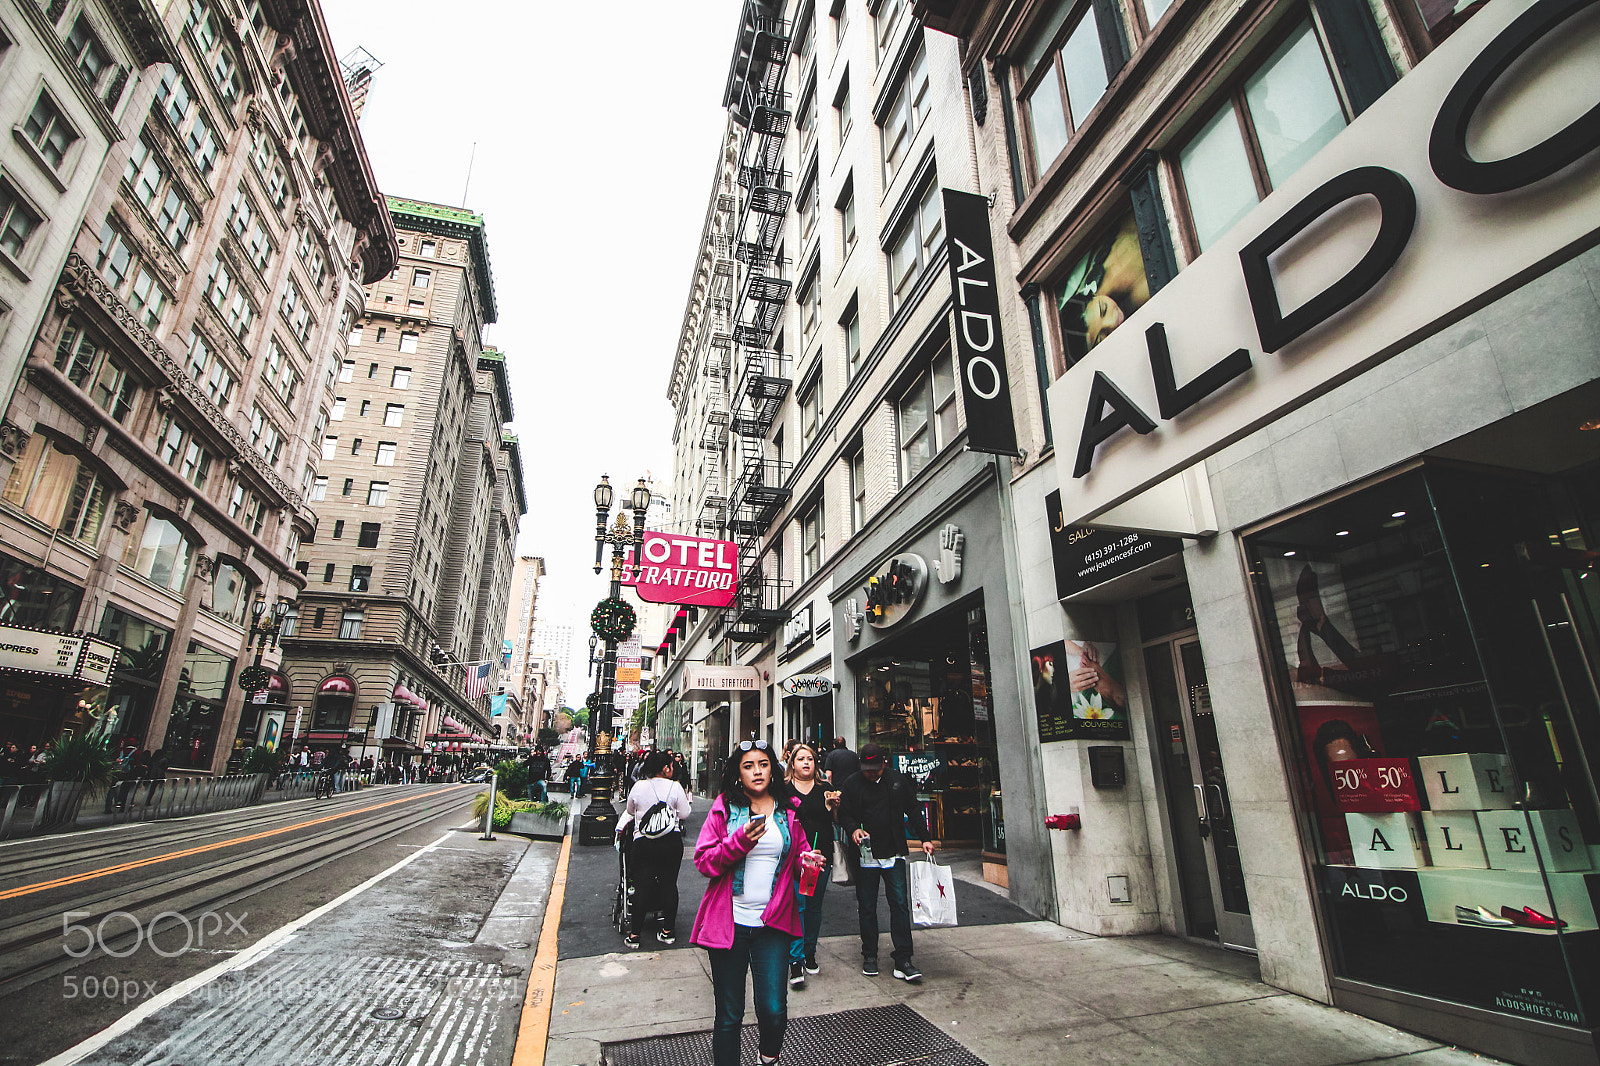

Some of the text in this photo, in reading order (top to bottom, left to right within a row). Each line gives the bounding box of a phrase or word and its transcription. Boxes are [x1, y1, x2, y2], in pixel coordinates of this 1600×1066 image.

[1073, 0, 1600, 479] ALDO
[953, 238, 1001, 400] ALDO
[1068, 528, 1096, 545] SALO
[1077, 539, 1152, 578] www.jouvencesf.com
[1084, 533, 1139, 565] (415) 391-1288
[620, 564, 733, 590] STRATFORD
[88, 652, 110, 664] EXPRESS
[697, 677, 716, 687] HOTEL
[1080, 720, 1124, 729] JOUVENCE
[1334, 768, 1367, 790] 50%
[1377, 766, 1408, 789] 50%
[1341, 882, 1408, 903] ALDO
[1495, 997, 1579, 1023] ALDOSHOES.COM
